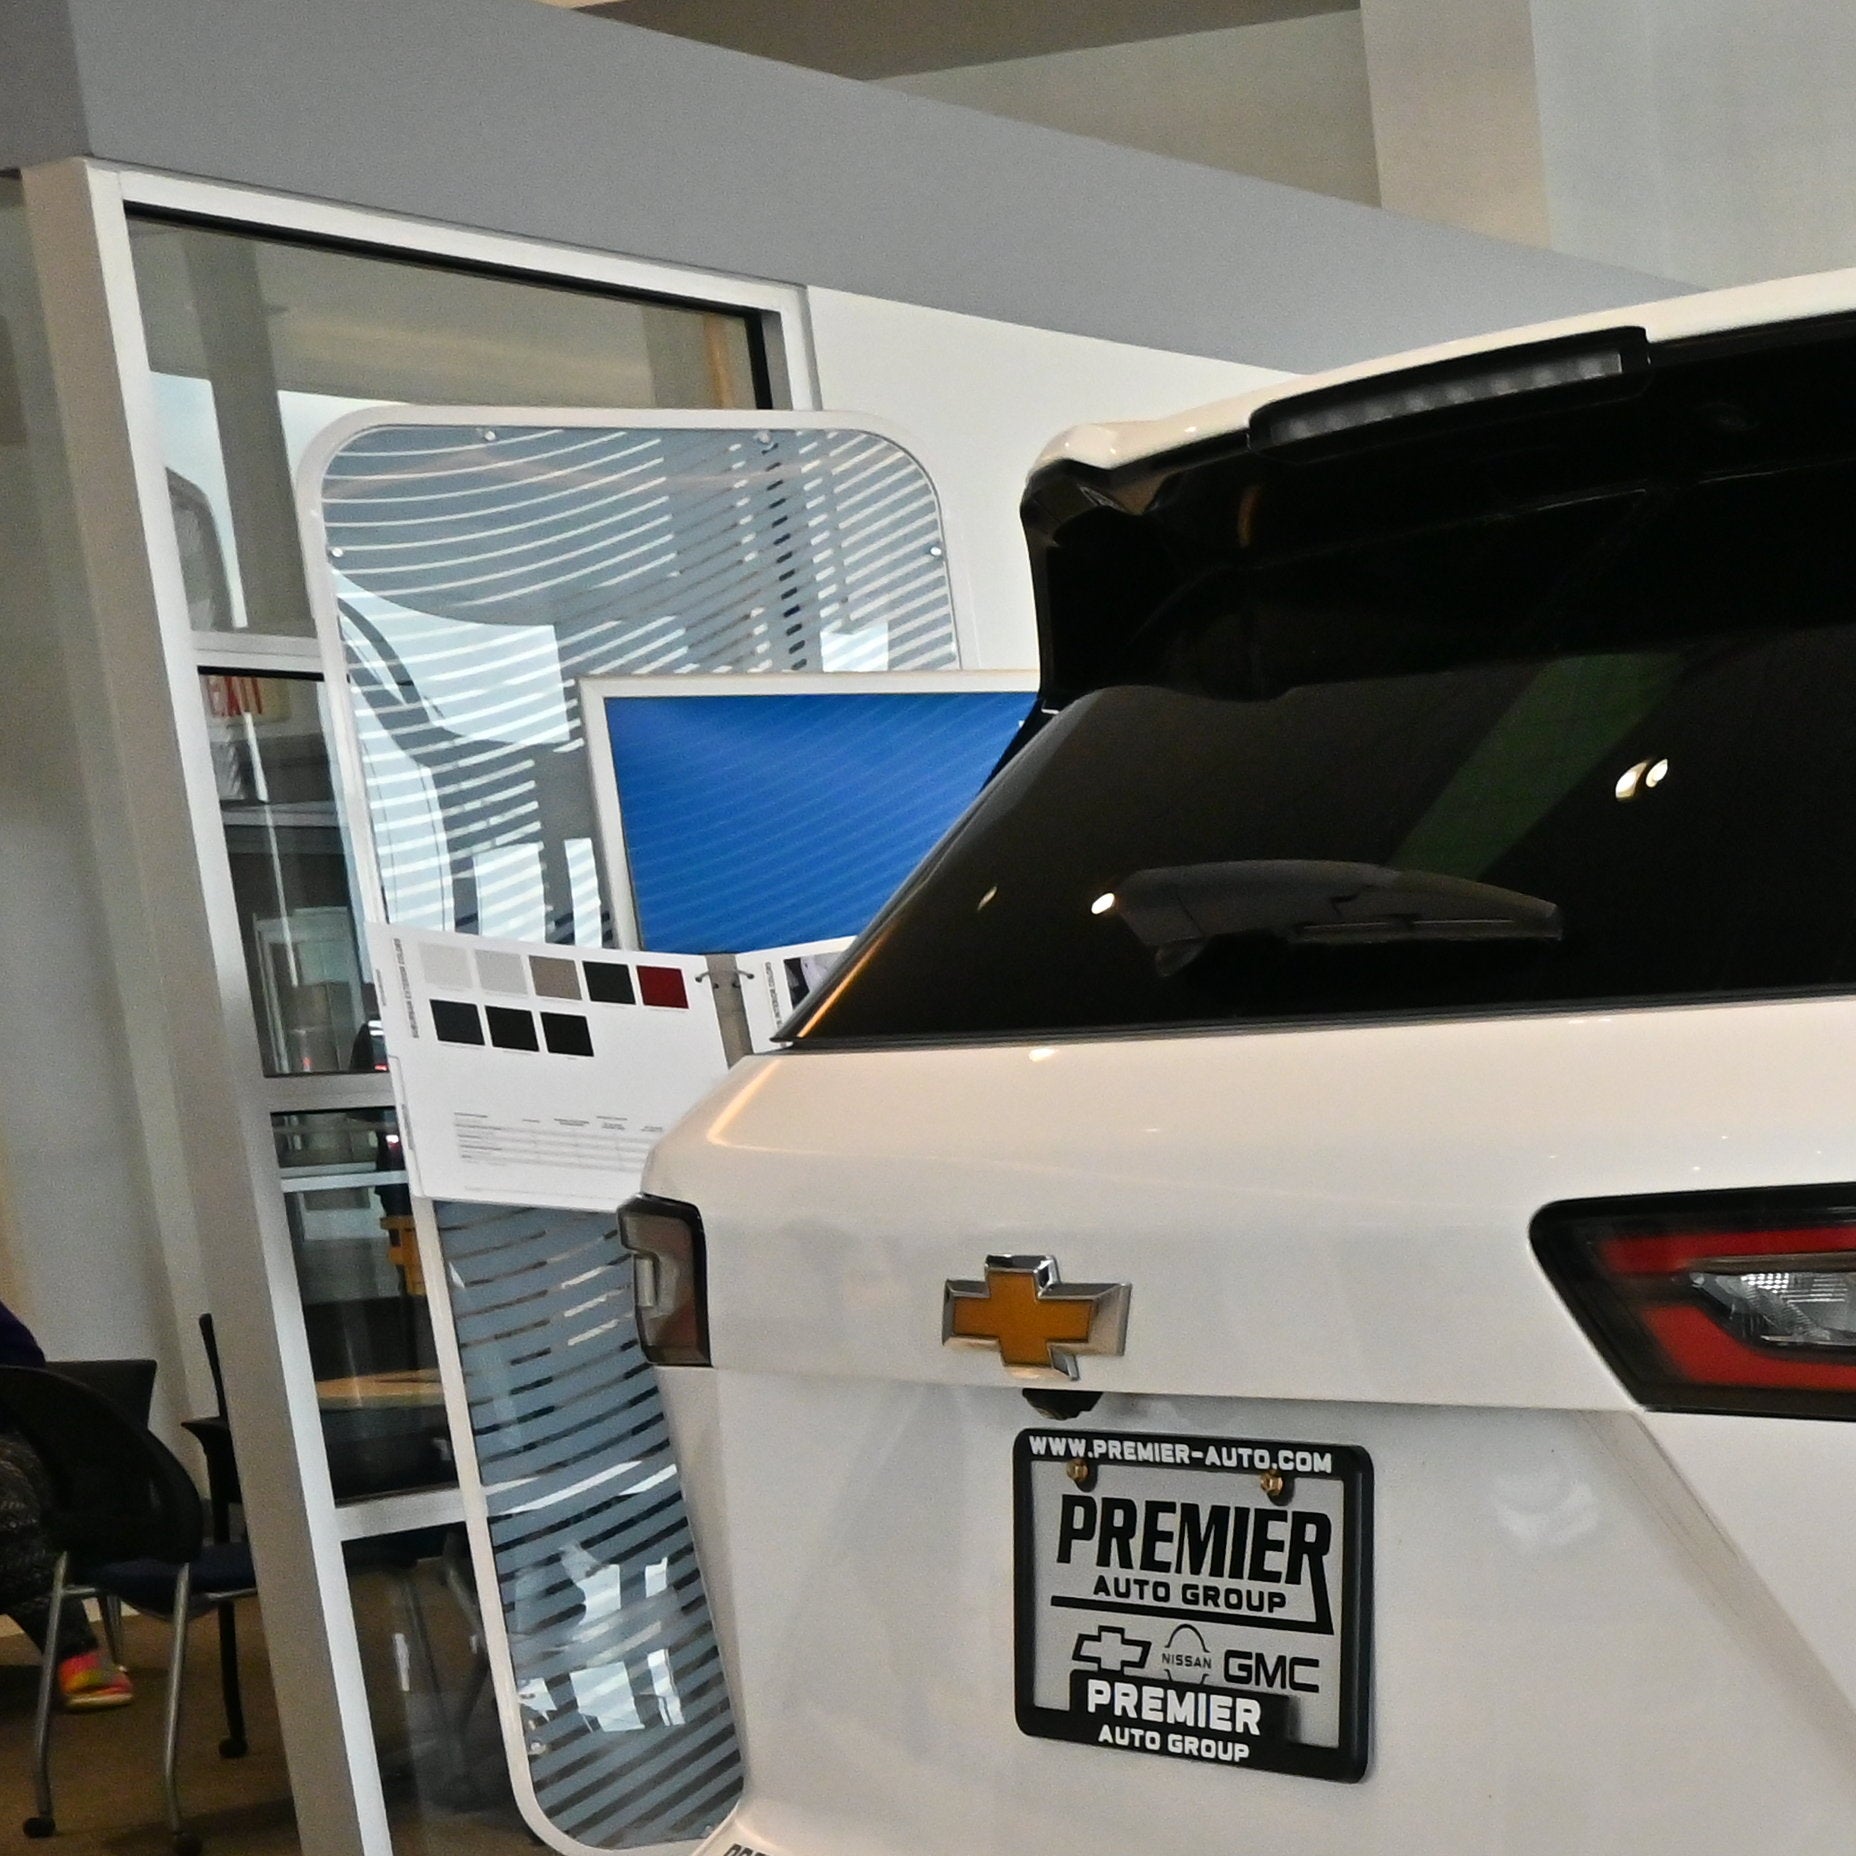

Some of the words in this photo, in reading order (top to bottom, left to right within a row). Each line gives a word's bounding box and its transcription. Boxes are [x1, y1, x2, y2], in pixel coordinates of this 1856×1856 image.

[1028, 1436, 1332, 1474] WWW.PREMIER-AUTO.COM
[1056, 1493, 1333, 1590] PREMIER
[1093, 1575, 1170, 1603] AUTO
[1181, 1584, 1287, 1614] GROUP
[1162, 1653, 1212, 1669] NISSAN
[1224, 1650, 1320, 1693] GMC
[1087, 1679, 1262, 1736] PREMIER
[1098, 1724, 1161, 1750] AUTO
[1167, 1734, 1250, 1762] GROUP
